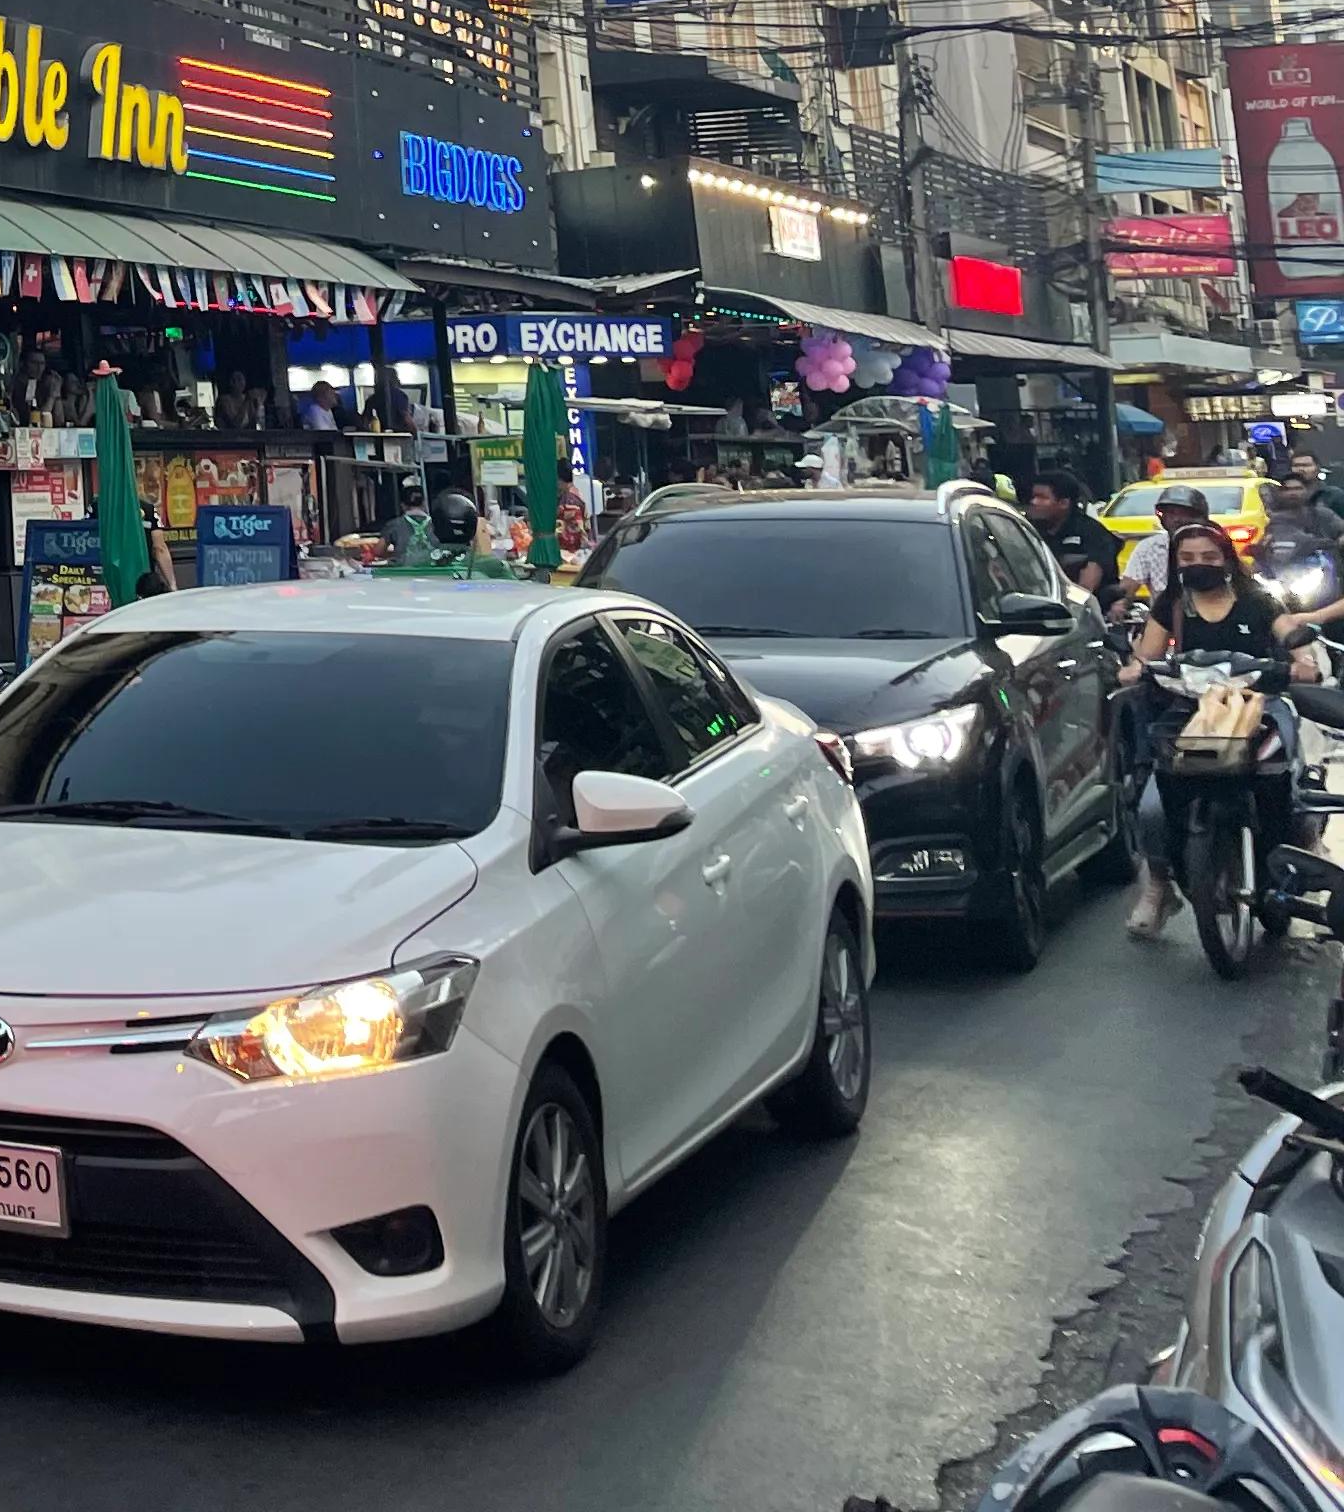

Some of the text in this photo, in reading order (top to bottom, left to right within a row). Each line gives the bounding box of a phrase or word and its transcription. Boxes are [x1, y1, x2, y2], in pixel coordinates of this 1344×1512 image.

[1271, 70, 1311, 84] LEO
[88, 41, 189, 176] Inn
[1245, 97, 1288, 111] WORLD
[1291, 96, 1308, 108] OF
[1278, 217, 1340, 239] LEO
[519, 318, 664, 355] EXCHANGE
[564, 367, 586, 476] EXCHA
[228, 514, 273, 537] Tiger
